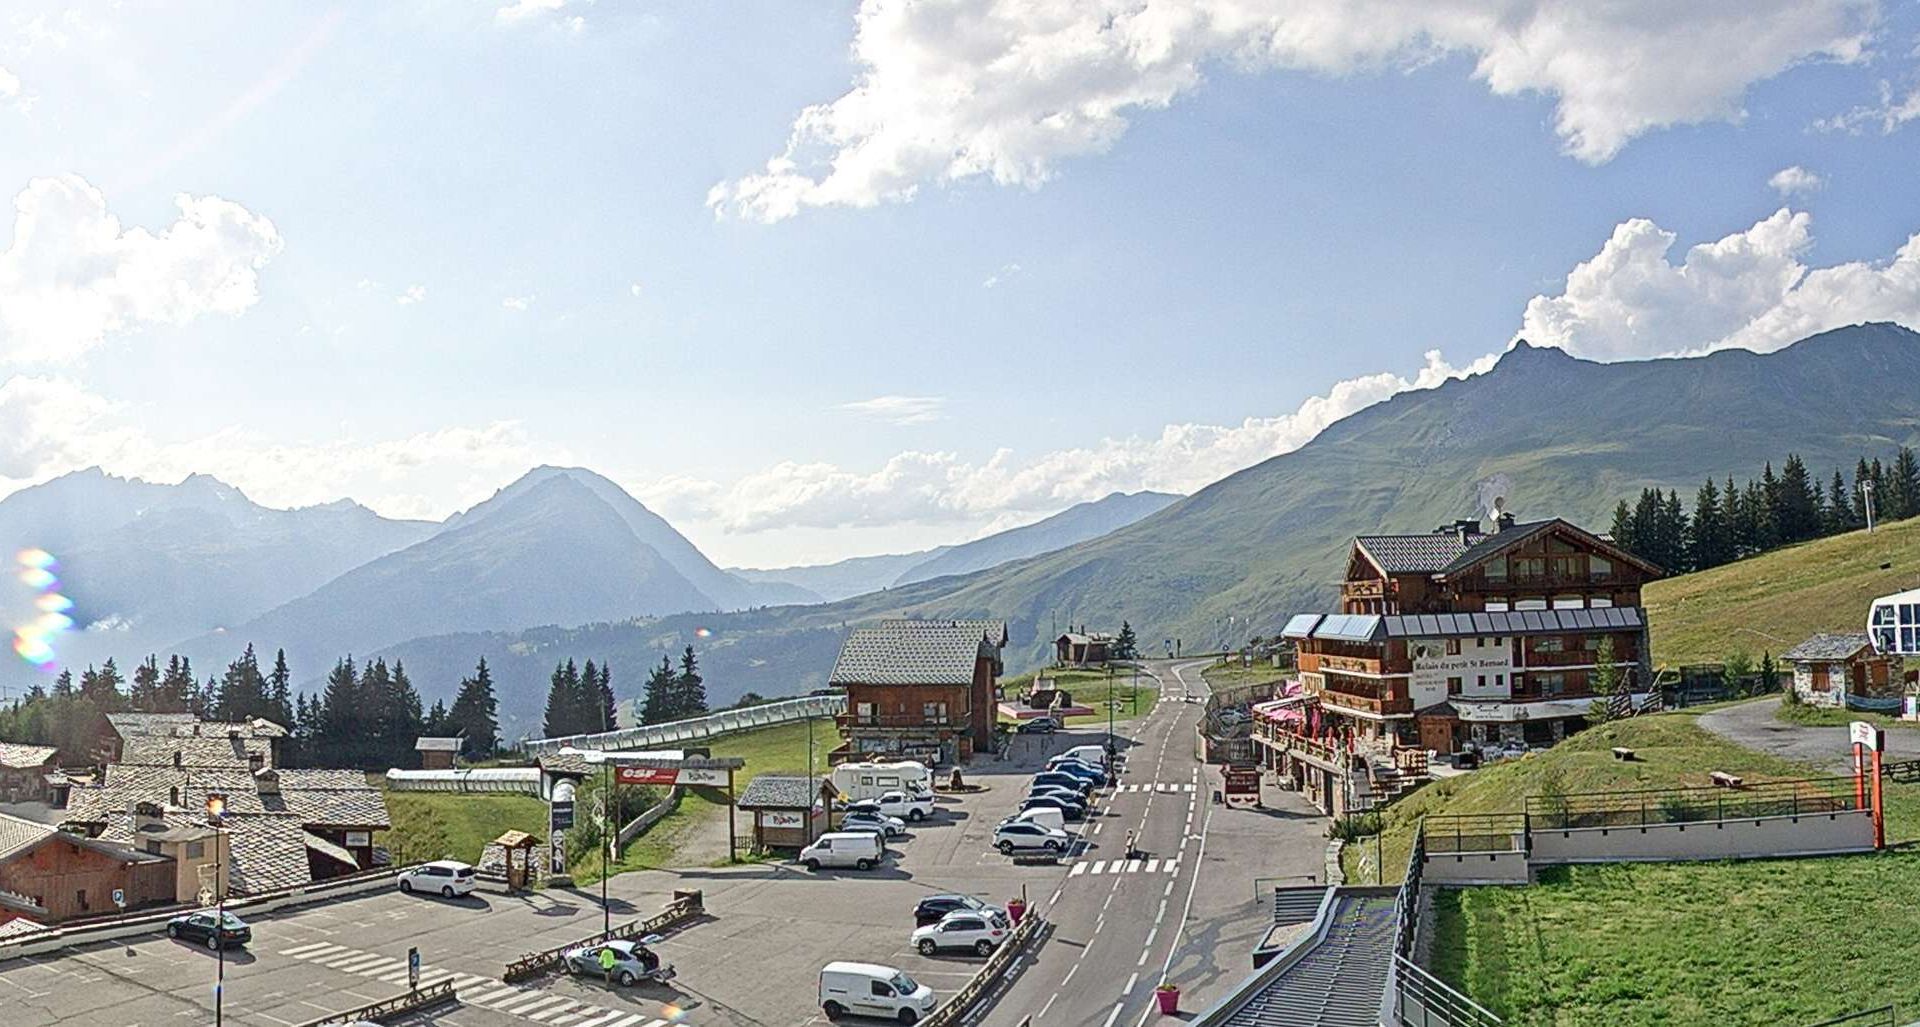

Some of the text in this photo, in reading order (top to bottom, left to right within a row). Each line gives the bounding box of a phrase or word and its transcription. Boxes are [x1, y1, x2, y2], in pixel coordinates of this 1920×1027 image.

[1415, 658, 1509, 671] Relais du petit St Bernard
